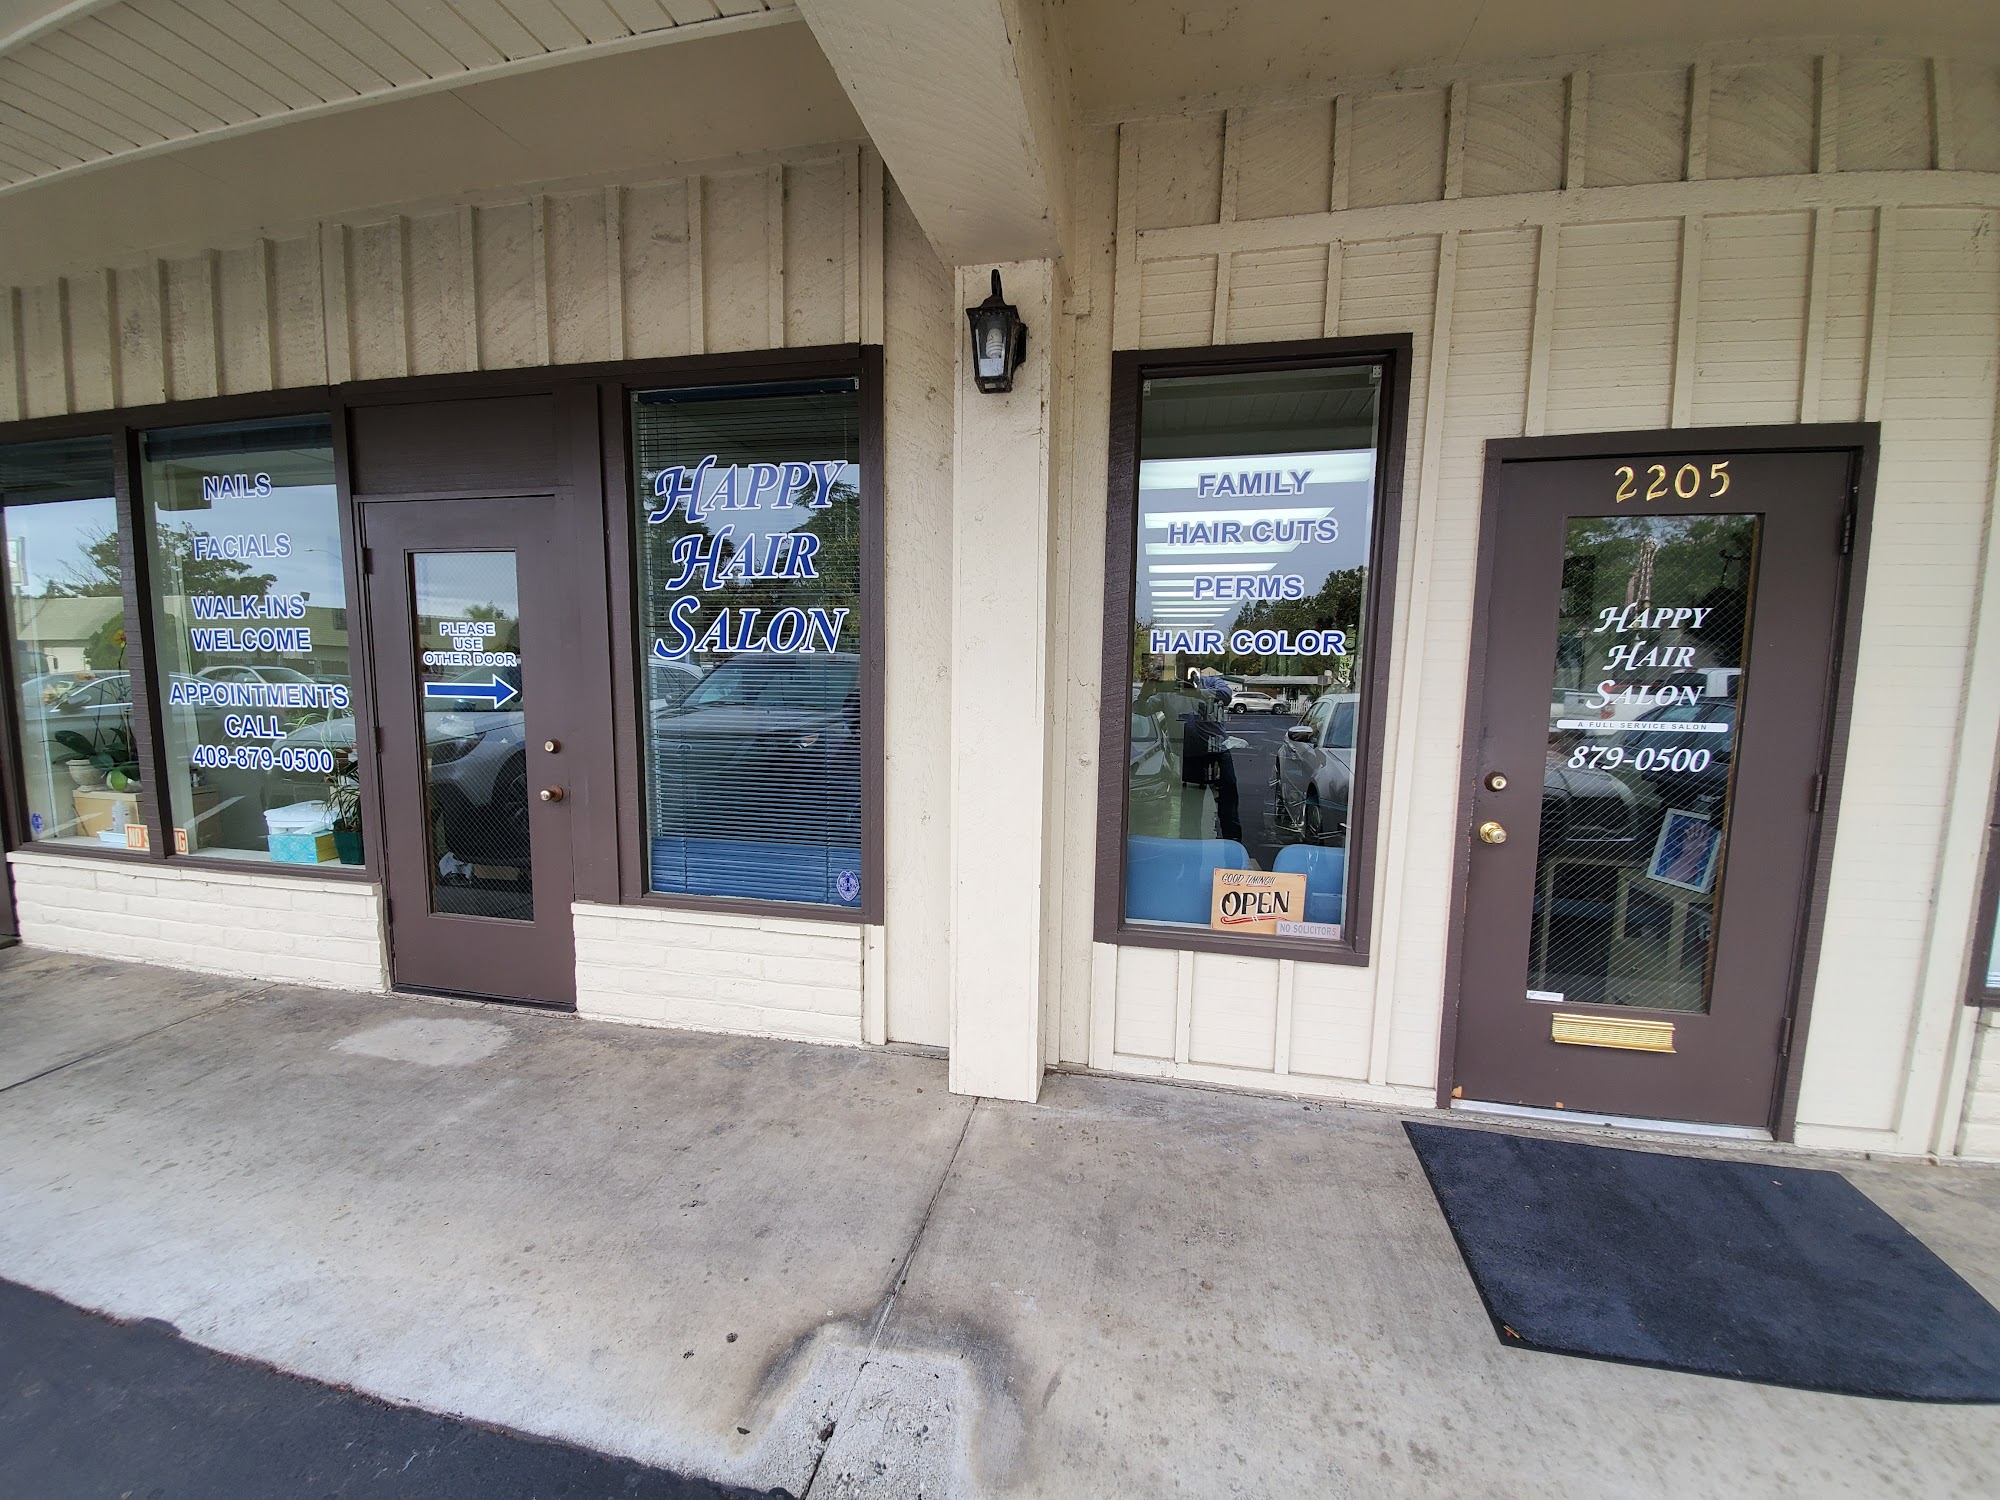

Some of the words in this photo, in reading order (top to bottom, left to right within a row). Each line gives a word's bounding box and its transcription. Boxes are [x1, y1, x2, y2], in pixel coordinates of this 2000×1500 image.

[203, 473, 272, 500] NAILS
[648, 455, 848, 523] HAPPY
[1198, 469, 1314, 498] FAMILY
[1614, 460, 1730, 503] 2205
[1168, 521, 1243, 545] HAIR
[1251, 517, 1338, 543] CUTS
[194, 533, 291, 560] FACIALS
[665, 524, 820, 591] HAIR
[1193, 575, 1304, 600] PERMS
[191, 594, 306, 619] WALK-INS
[1593, 602, 1713, 632] HAPPY
[191, 627, 312, 652] WELCOME
[440, 622, 496, 636] PLEASE
[654, 595, 849, 660] SALON
[453, 637, 484, 651] USE
[1150, 629, 1224, 654] HAIR
[1231, 629, 1346, 655] COLOR
[1602, 640, 1696, 671] HAIR
[423, 651, 473, 666] OTHER
[474, 652, 517, 667] DOOR
[169, 683, 349, 708] APPOINTMENTS
[1585, 679, 1705, 709] SALON
[225, 714, 287, 739] CALL
[1589, 721, 1615, 729] FULL
[1620, 722, 1666, 730] SERVICE
[193, 745, 334, 773] 408-879-0500
[1567, 745, 1711, 773] 879-0500
[128, 827, 142, 847] NO
[1222, 873, 1244, 884] GOOD
[1220, 890, 1290, 917] OPEN
[1280, 923, 1291, 933] NO
[1293, 924, 1337, 936] SOLICITORS
